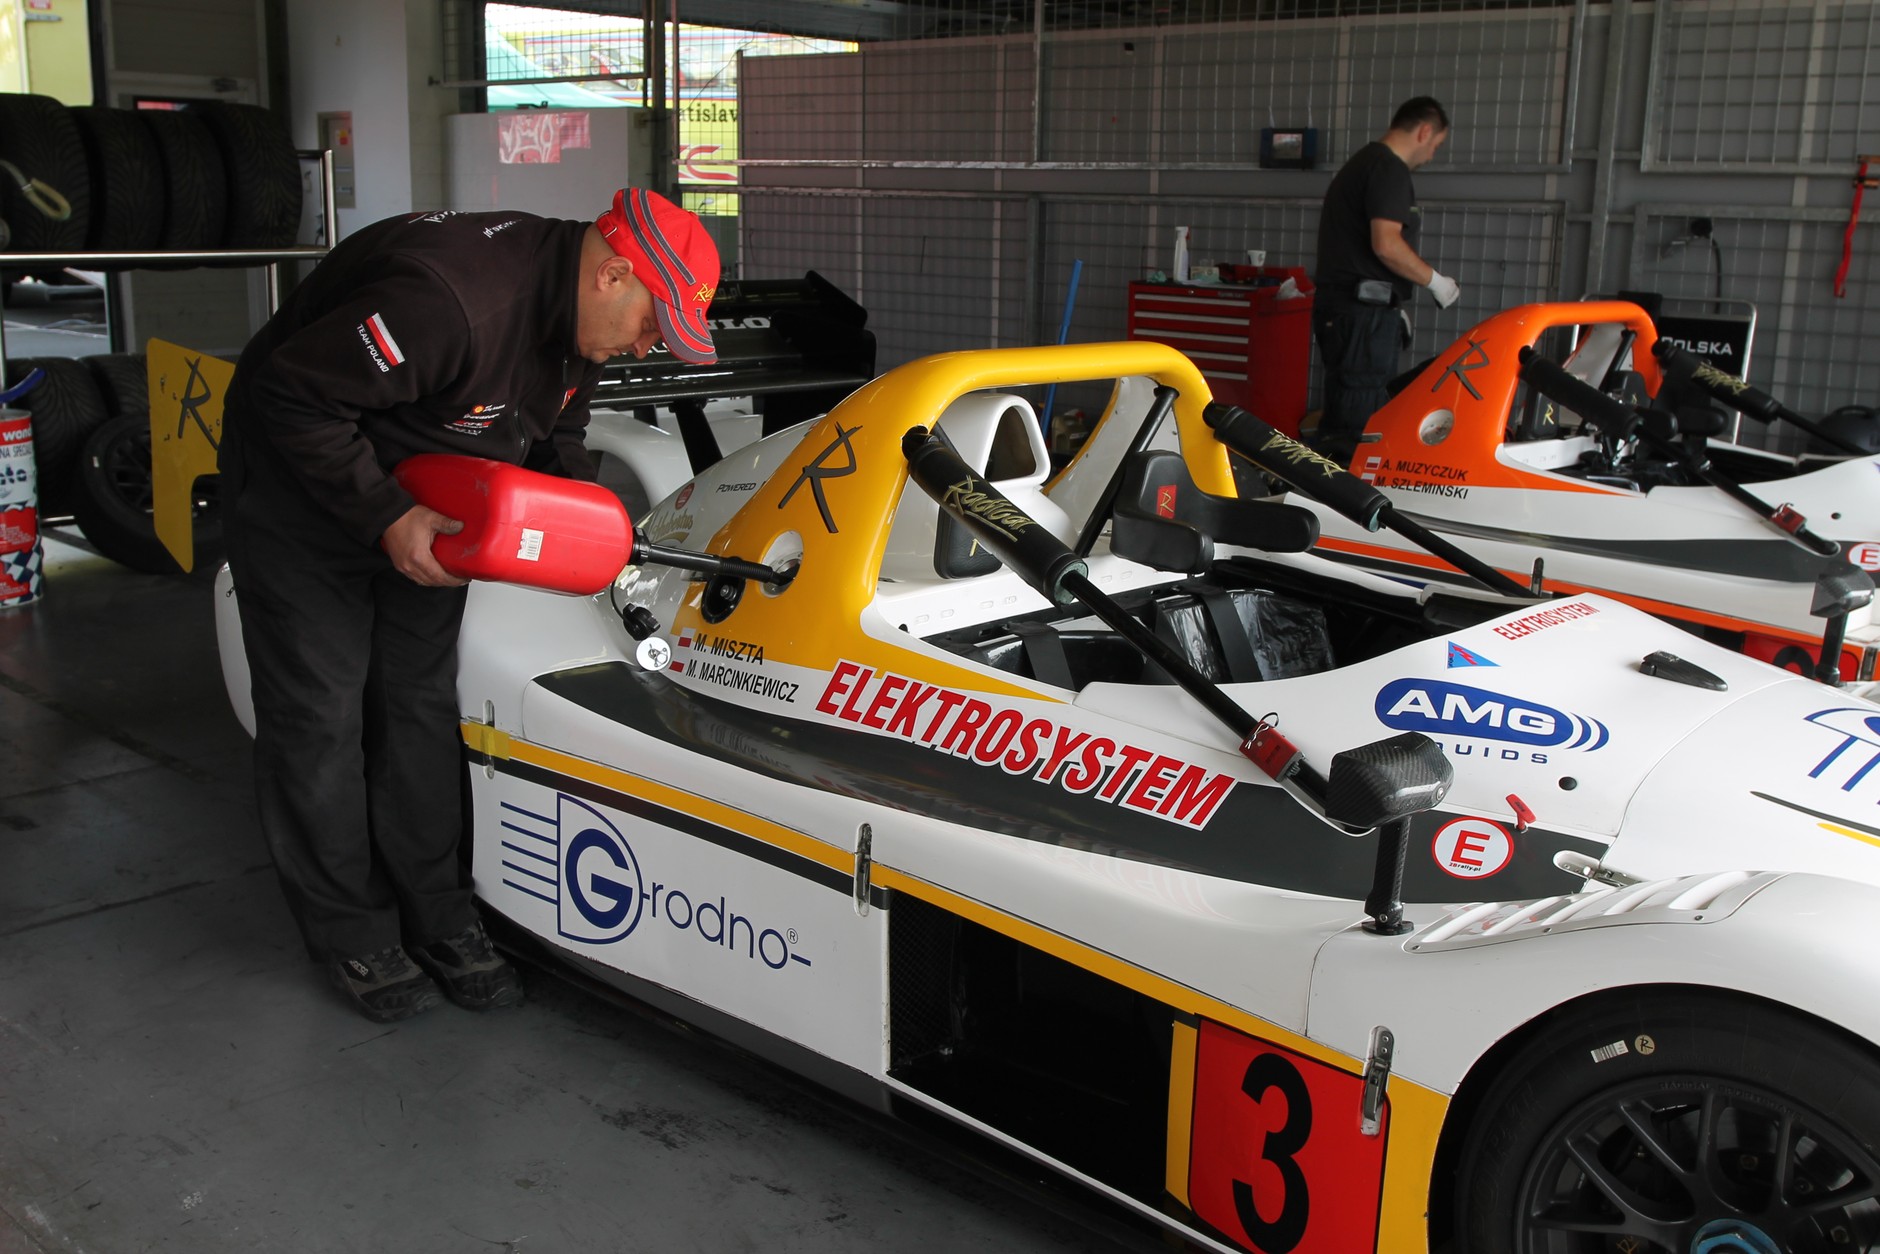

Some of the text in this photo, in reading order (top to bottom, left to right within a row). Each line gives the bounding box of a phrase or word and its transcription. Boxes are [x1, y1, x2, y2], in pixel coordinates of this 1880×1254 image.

[357, 323, 389, 373] TEAM POLAND
[716, 483, 757, 493] POWERED
[1375, 476, 1387, 488] M.
[1381, 459, 1468, 481] A. MUZYCZUK
[1492, 602, 1600, 640] ELEKTROSYSTEM
[693, 633, 764, 665] M. MISZTA
[685, 659, 800, 703] M. MARCINKIEWICZ
[1387, 689, 1556, 736] AMG
[813, 660, 1236, 828] ELEKTROSYSTEM
[1435, 741, 1548, 764] UIDS
[1451, 830, 1491, 866] E
[1232, 1053, 1312, 1254] 3
